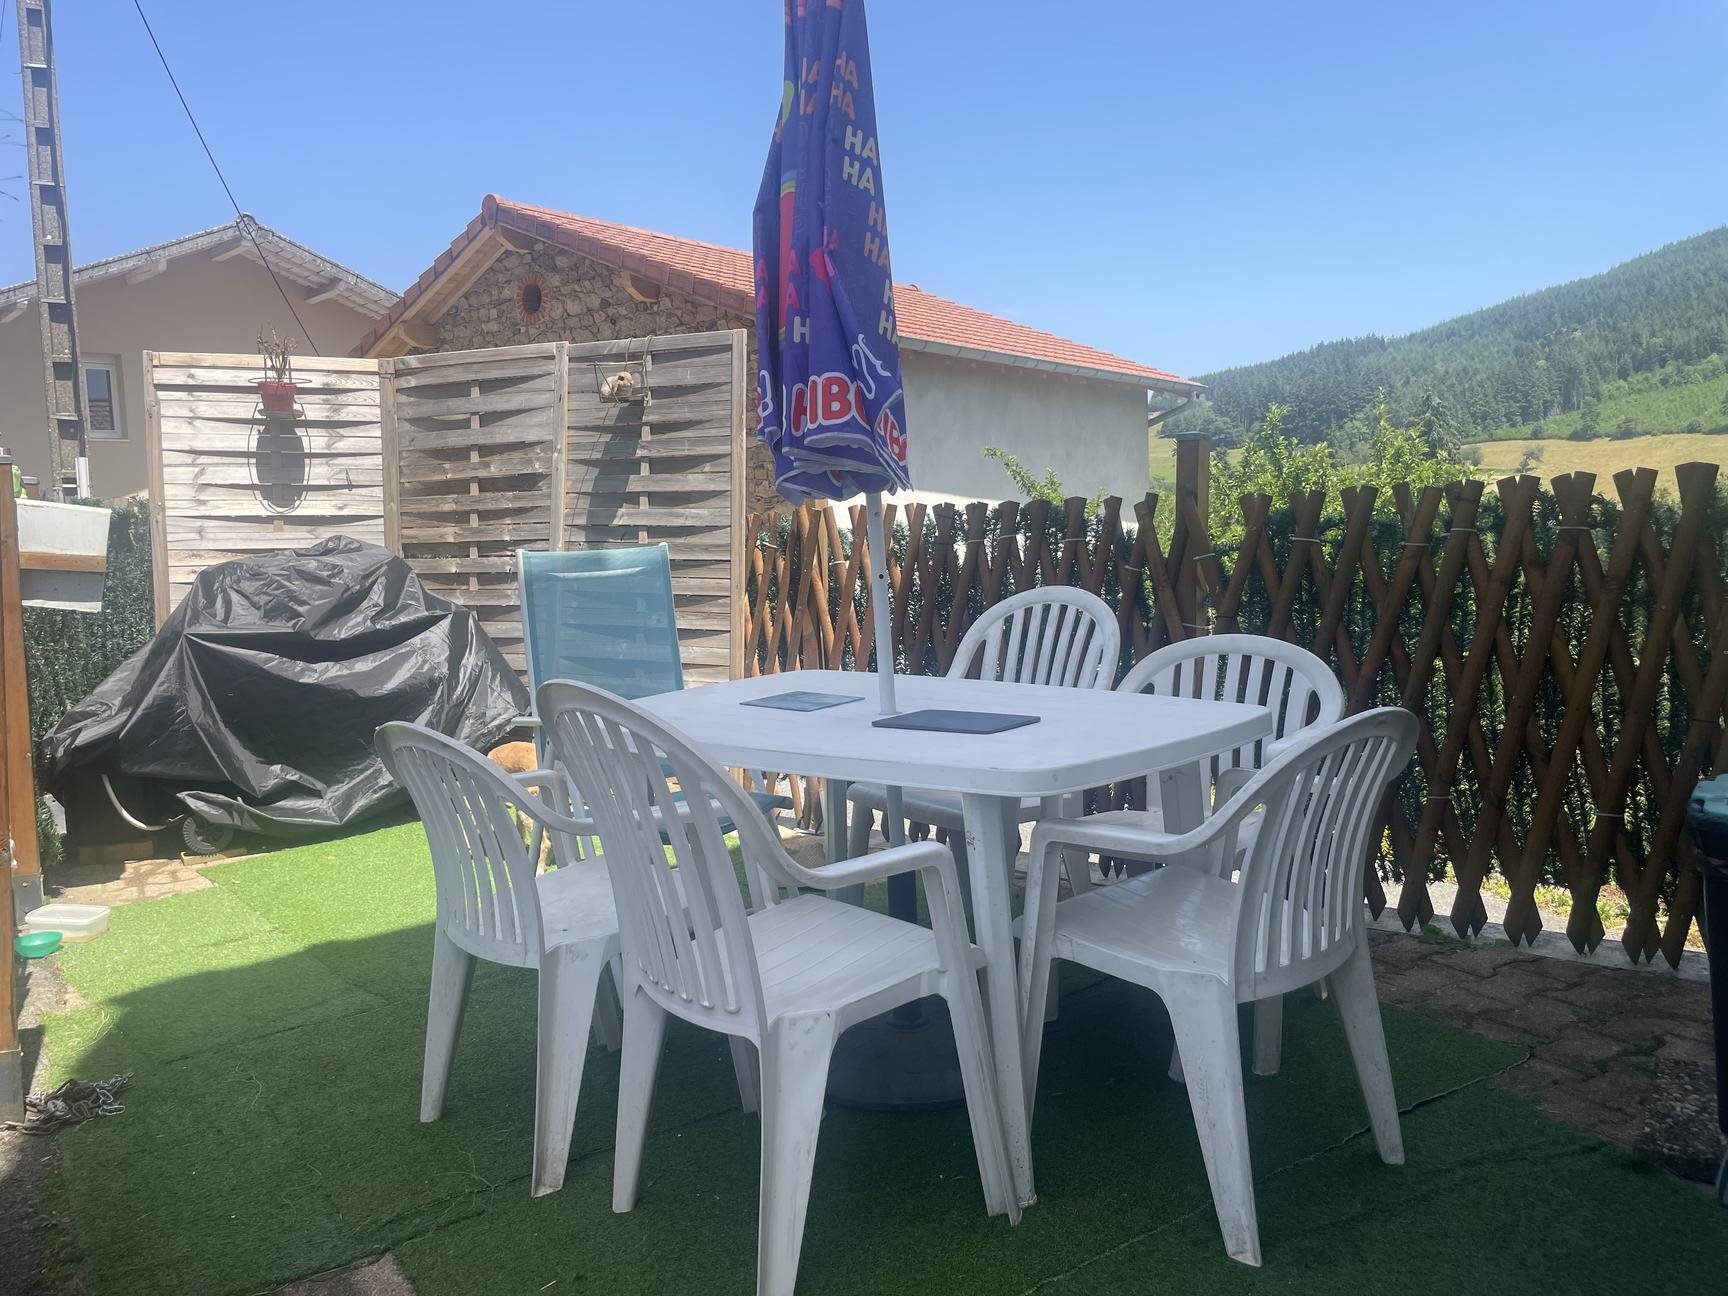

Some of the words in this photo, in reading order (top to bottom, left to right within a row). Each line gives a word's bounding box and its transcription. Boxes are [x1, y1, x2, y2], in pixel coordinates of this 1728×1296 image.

[834, 50, 859, 89] HA
[830, 81, 856, 120] HA
[845, 125, 878, 167] HA
[842, 155, 875, 197] HA
